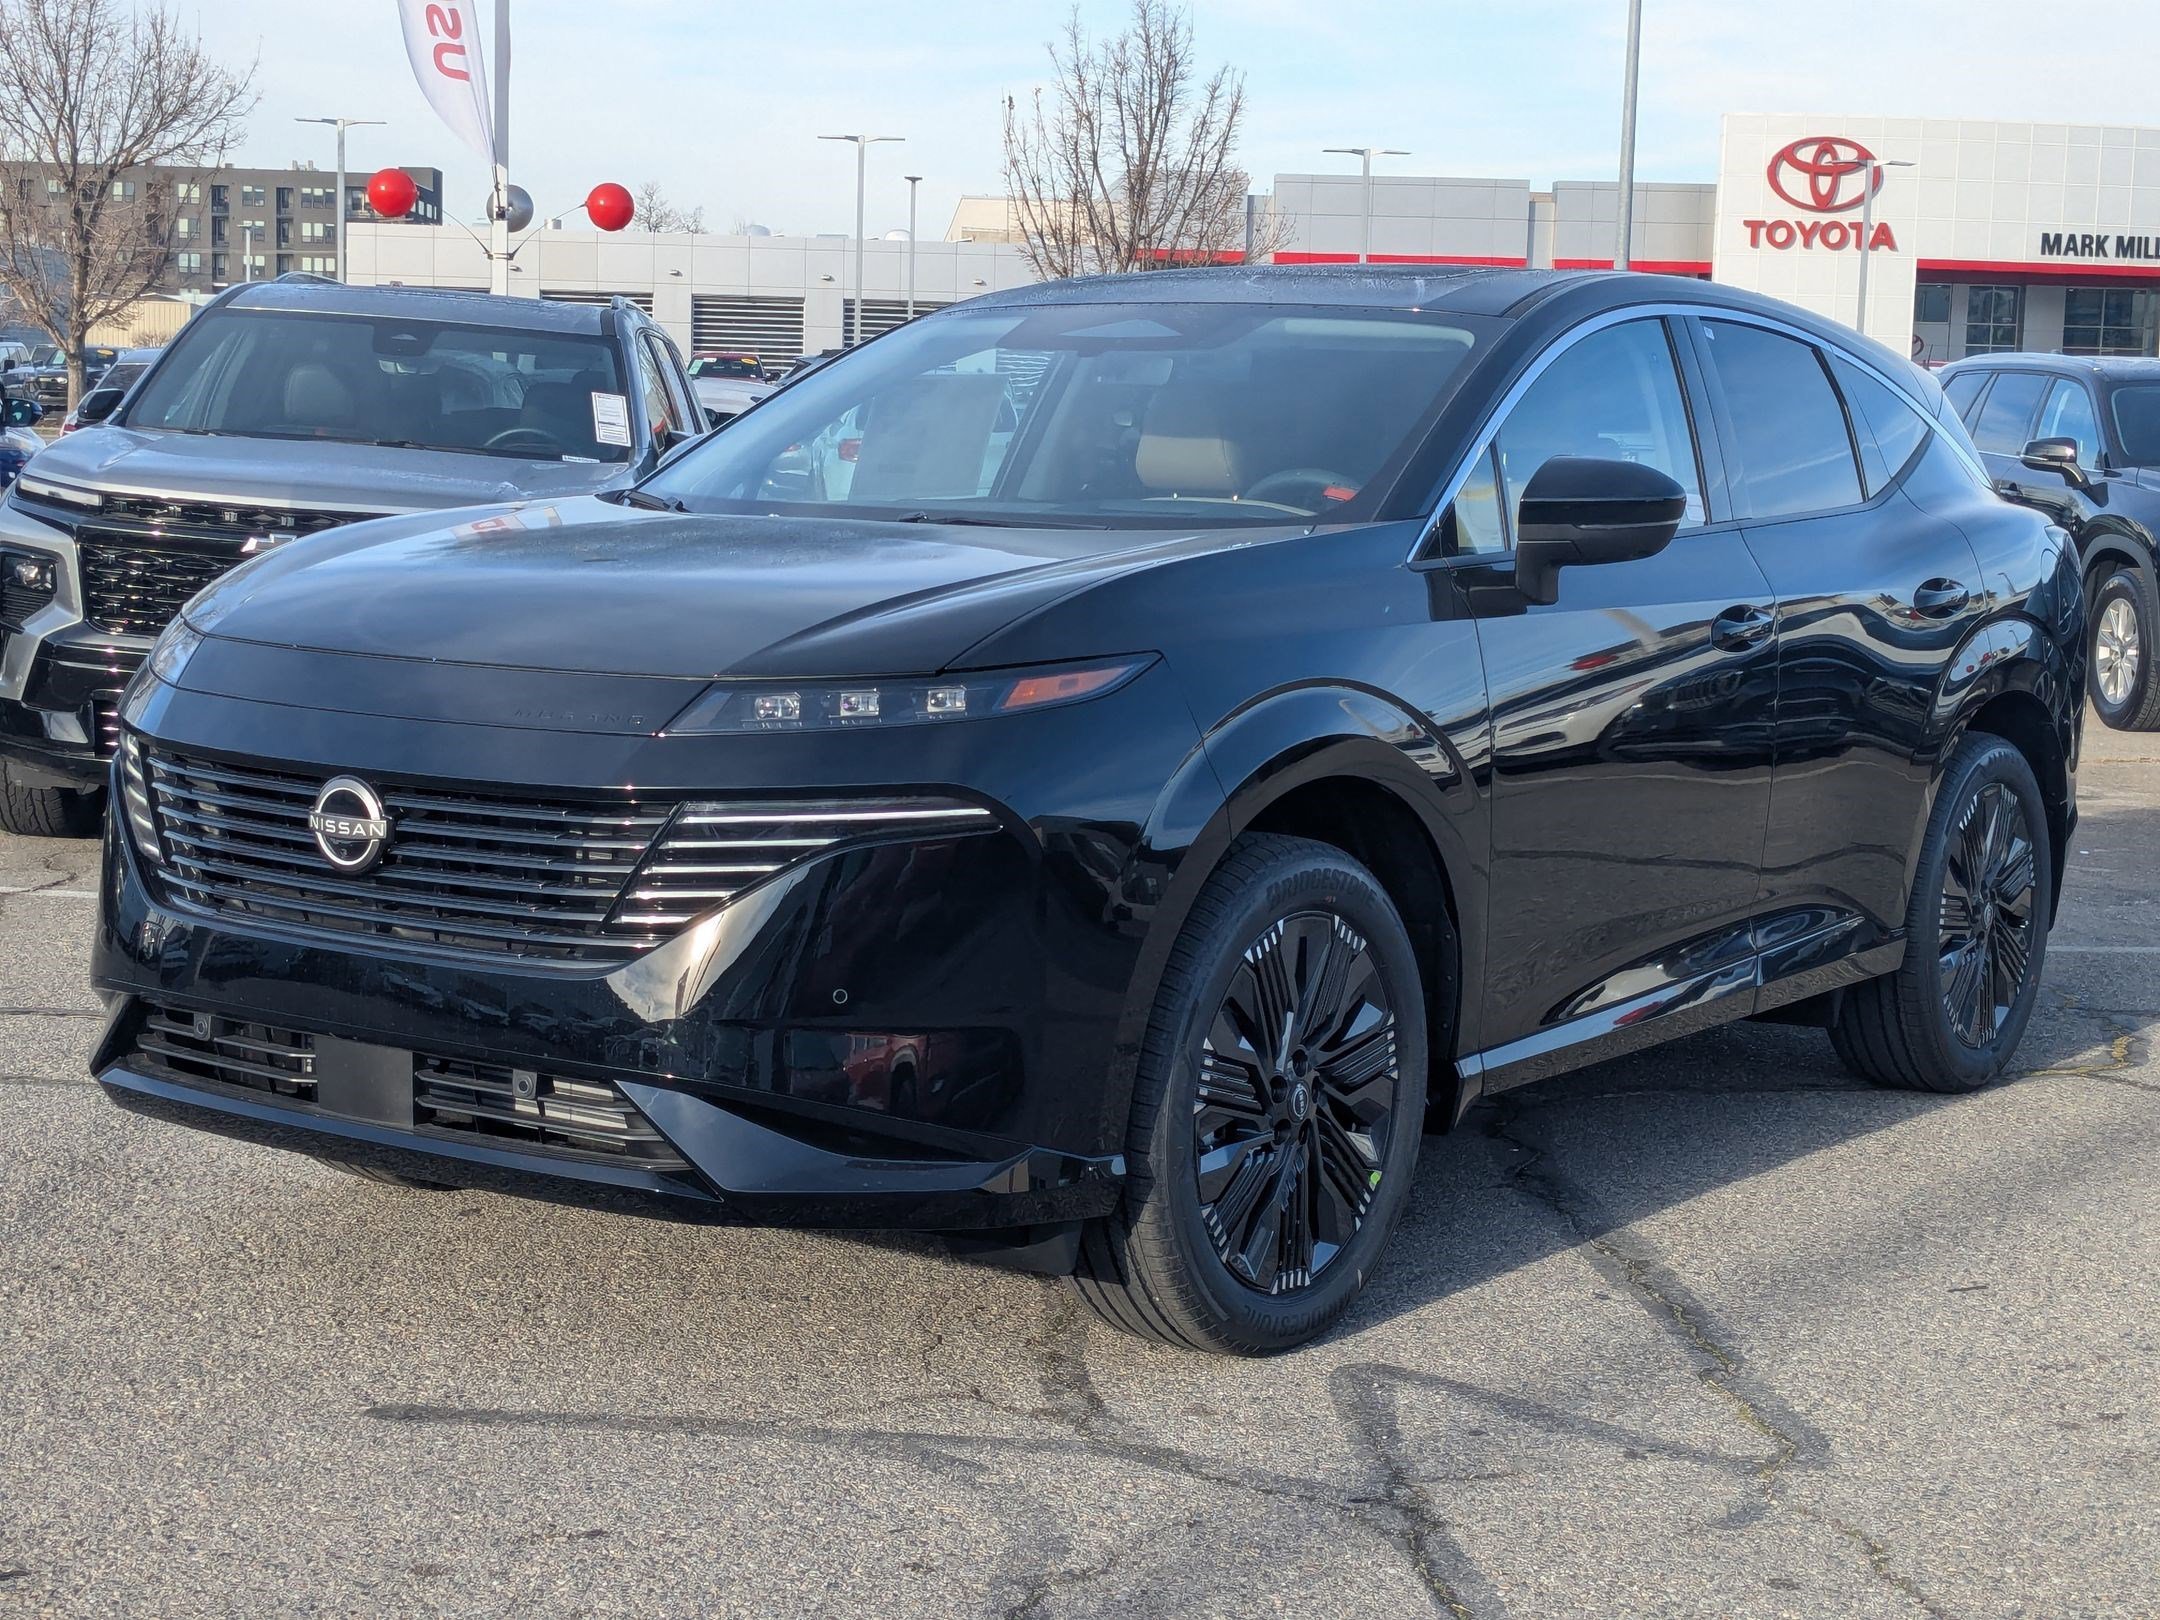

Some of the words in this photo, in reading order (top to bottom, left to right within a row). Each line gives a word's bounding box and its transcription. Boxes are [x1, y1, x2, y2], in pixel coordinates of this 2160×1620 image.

[1743, 219, 1898, 251] TOYOTA
[2041, 233, 2109, 257] MARK
[309, 814, 385, 837] NISSAN
[1266, 868, 1377, 912] BRIDGESTONE
